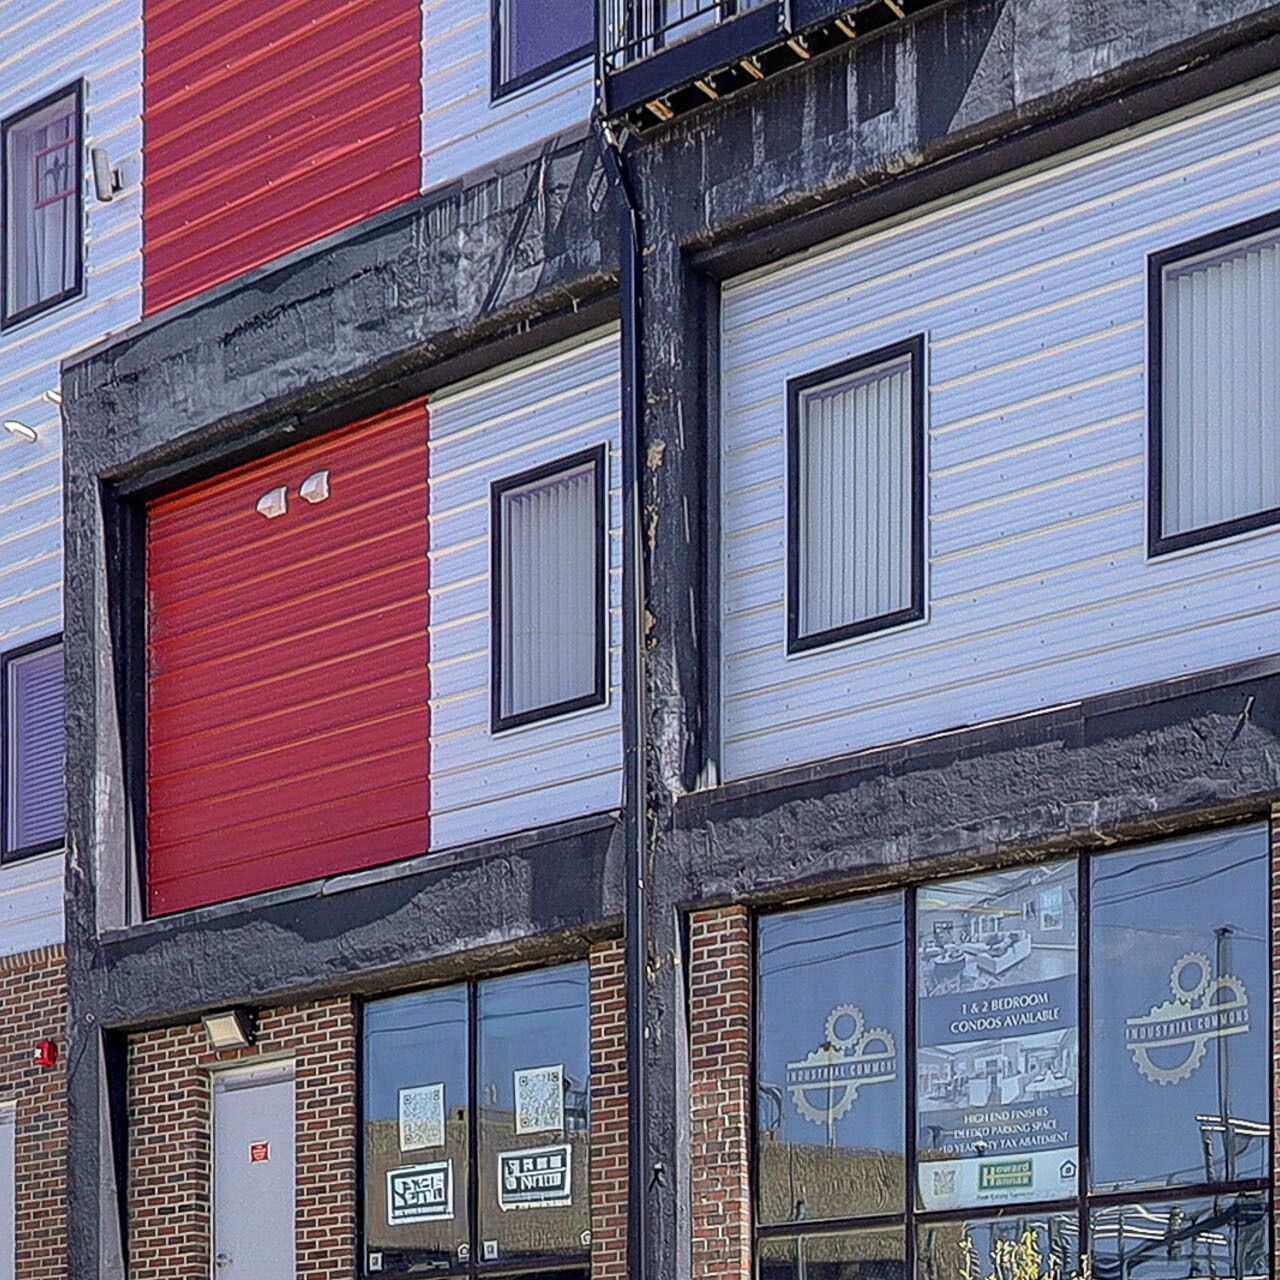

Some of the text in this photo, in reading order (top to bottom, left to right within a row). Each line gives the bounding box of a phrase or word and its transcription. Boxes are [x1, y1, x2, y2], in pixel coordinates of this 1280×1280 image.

[961, 992, 1049, 1015] 1 & 2 BEDROOM
[950, 1007, 1060, 1033] CONDOS AVAILABLE
[1125, 1009, 1249, 1040] INDUSTRIAL COMMONS
[786, 1060, 897, 1082] INDUSTRIAL COMMONS
[991, 1122, 1030, 1135] PARKING
[1031, 1119, 1057, 1130] SPACE
[1000, 1138, 1017, 1149] TAX
[1018, 1131, 1069, 1147] ABATEMENT
